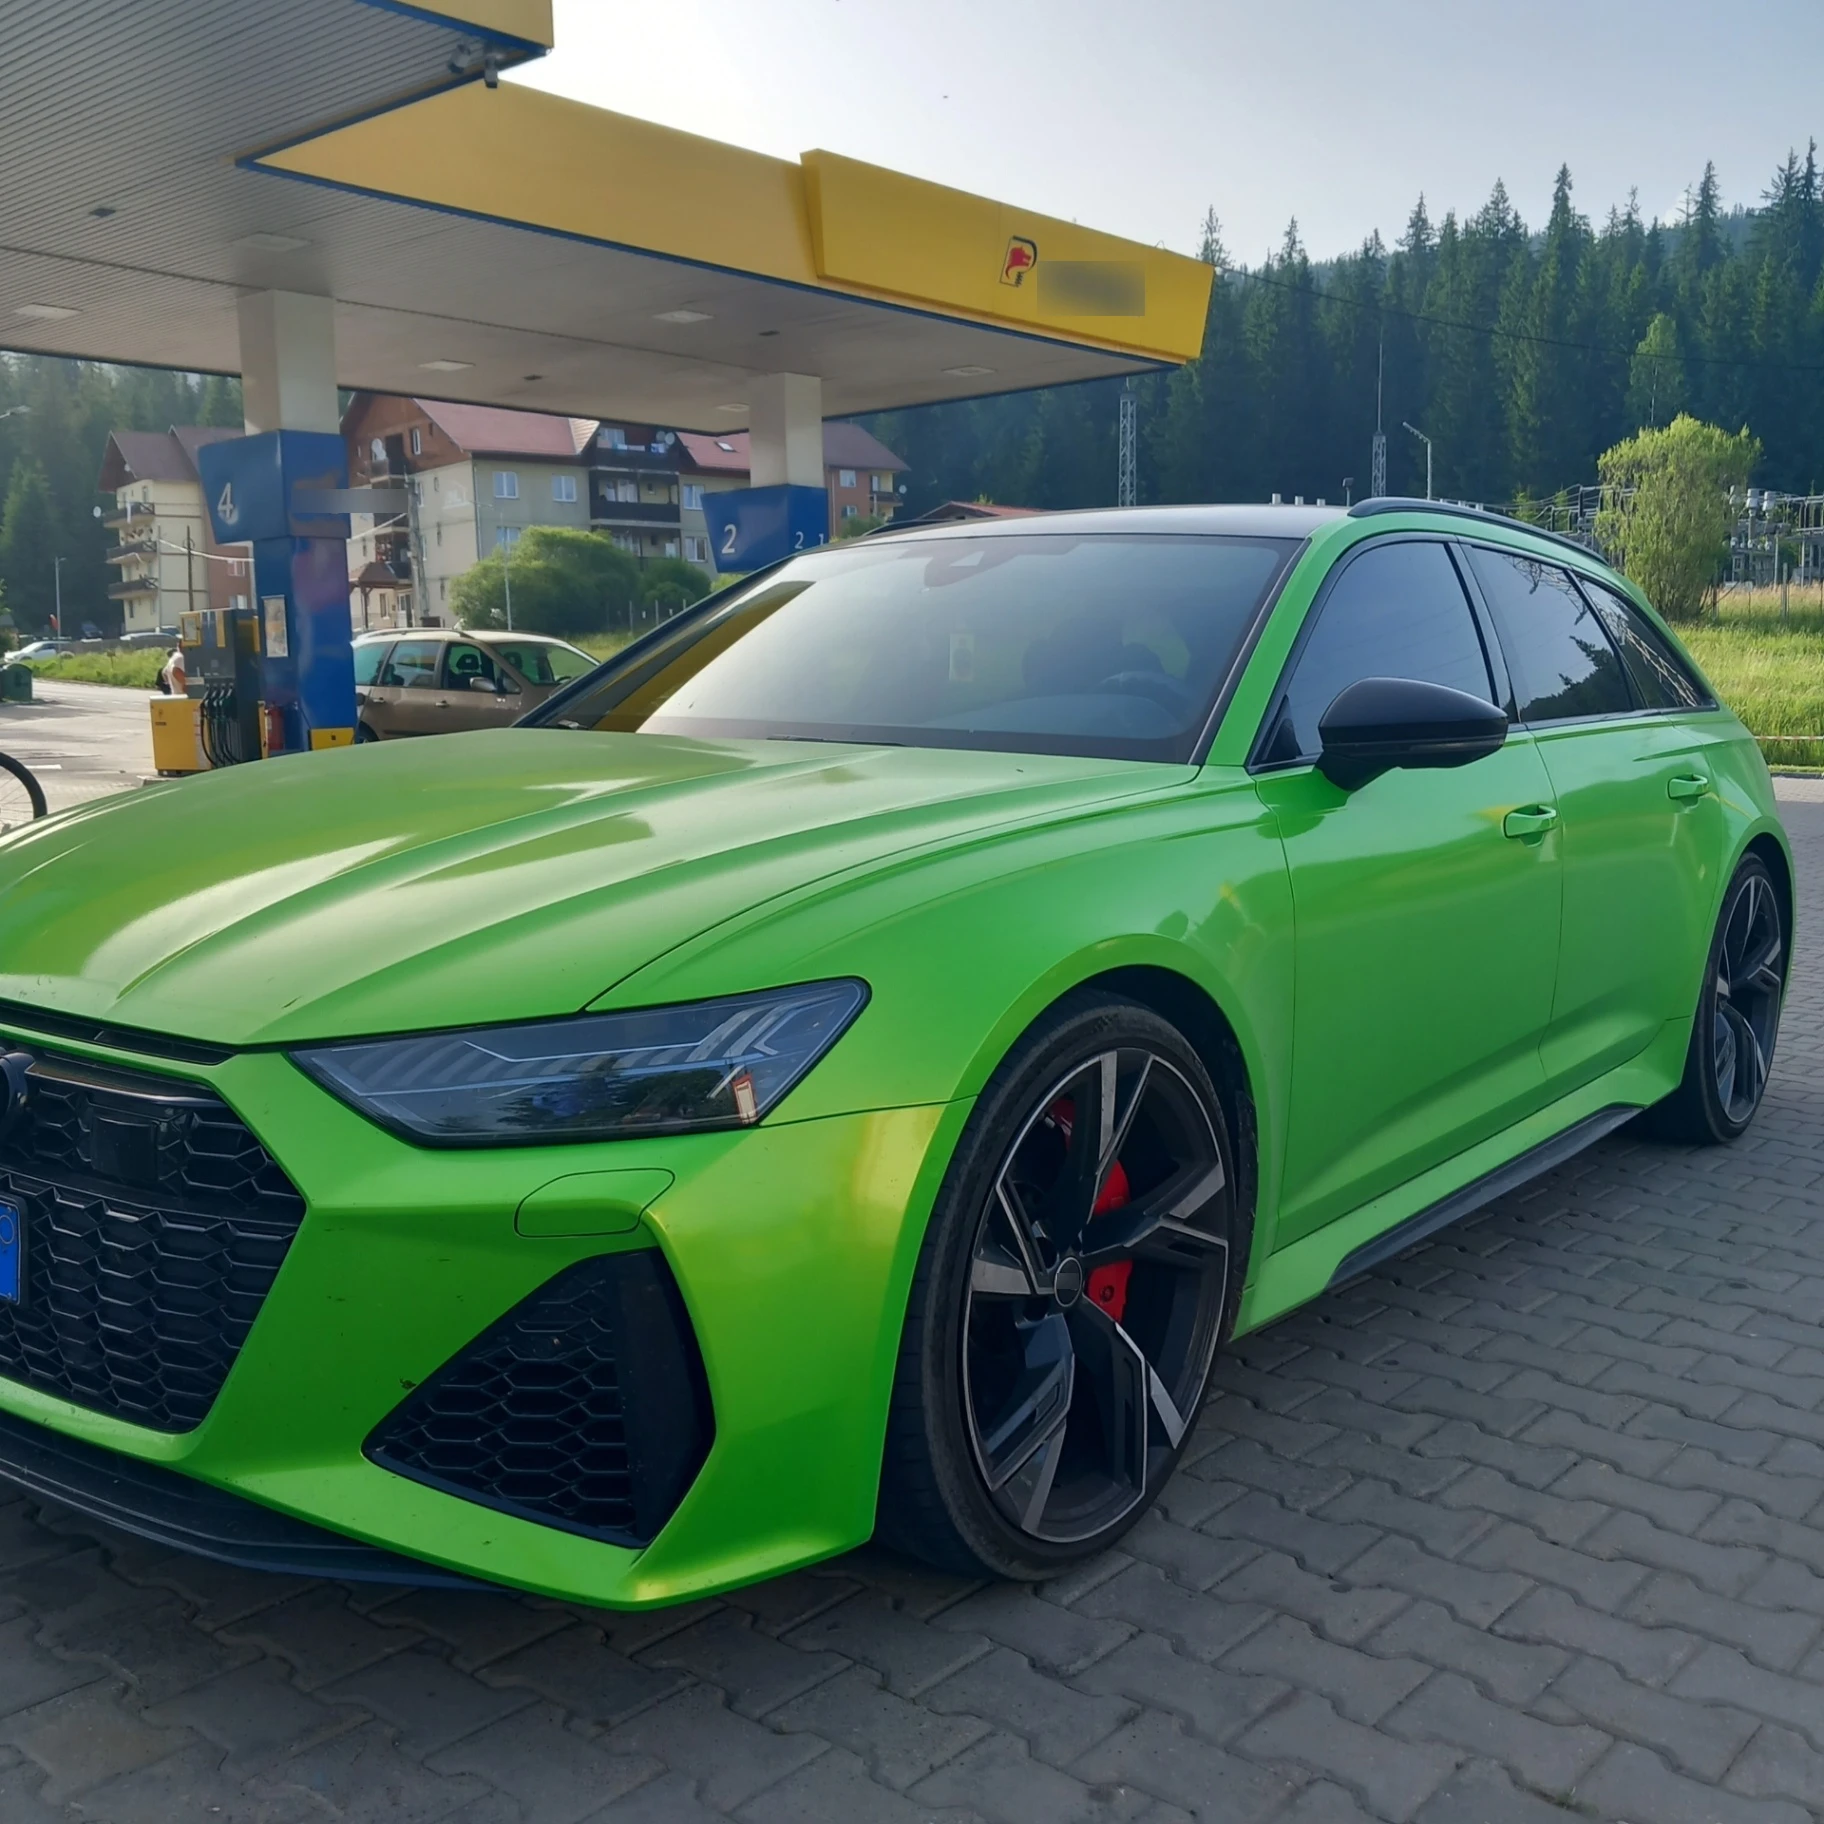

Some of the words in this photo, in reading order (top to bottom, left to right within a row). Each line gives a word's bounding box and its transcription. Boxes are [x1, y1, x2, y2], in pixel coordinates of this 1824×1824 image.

[217, 482, 234, 519] 4
[721, 524, 737, 554] 2
[795, 531, 804, 549] 2
[818, 533, 824, 545] 1
